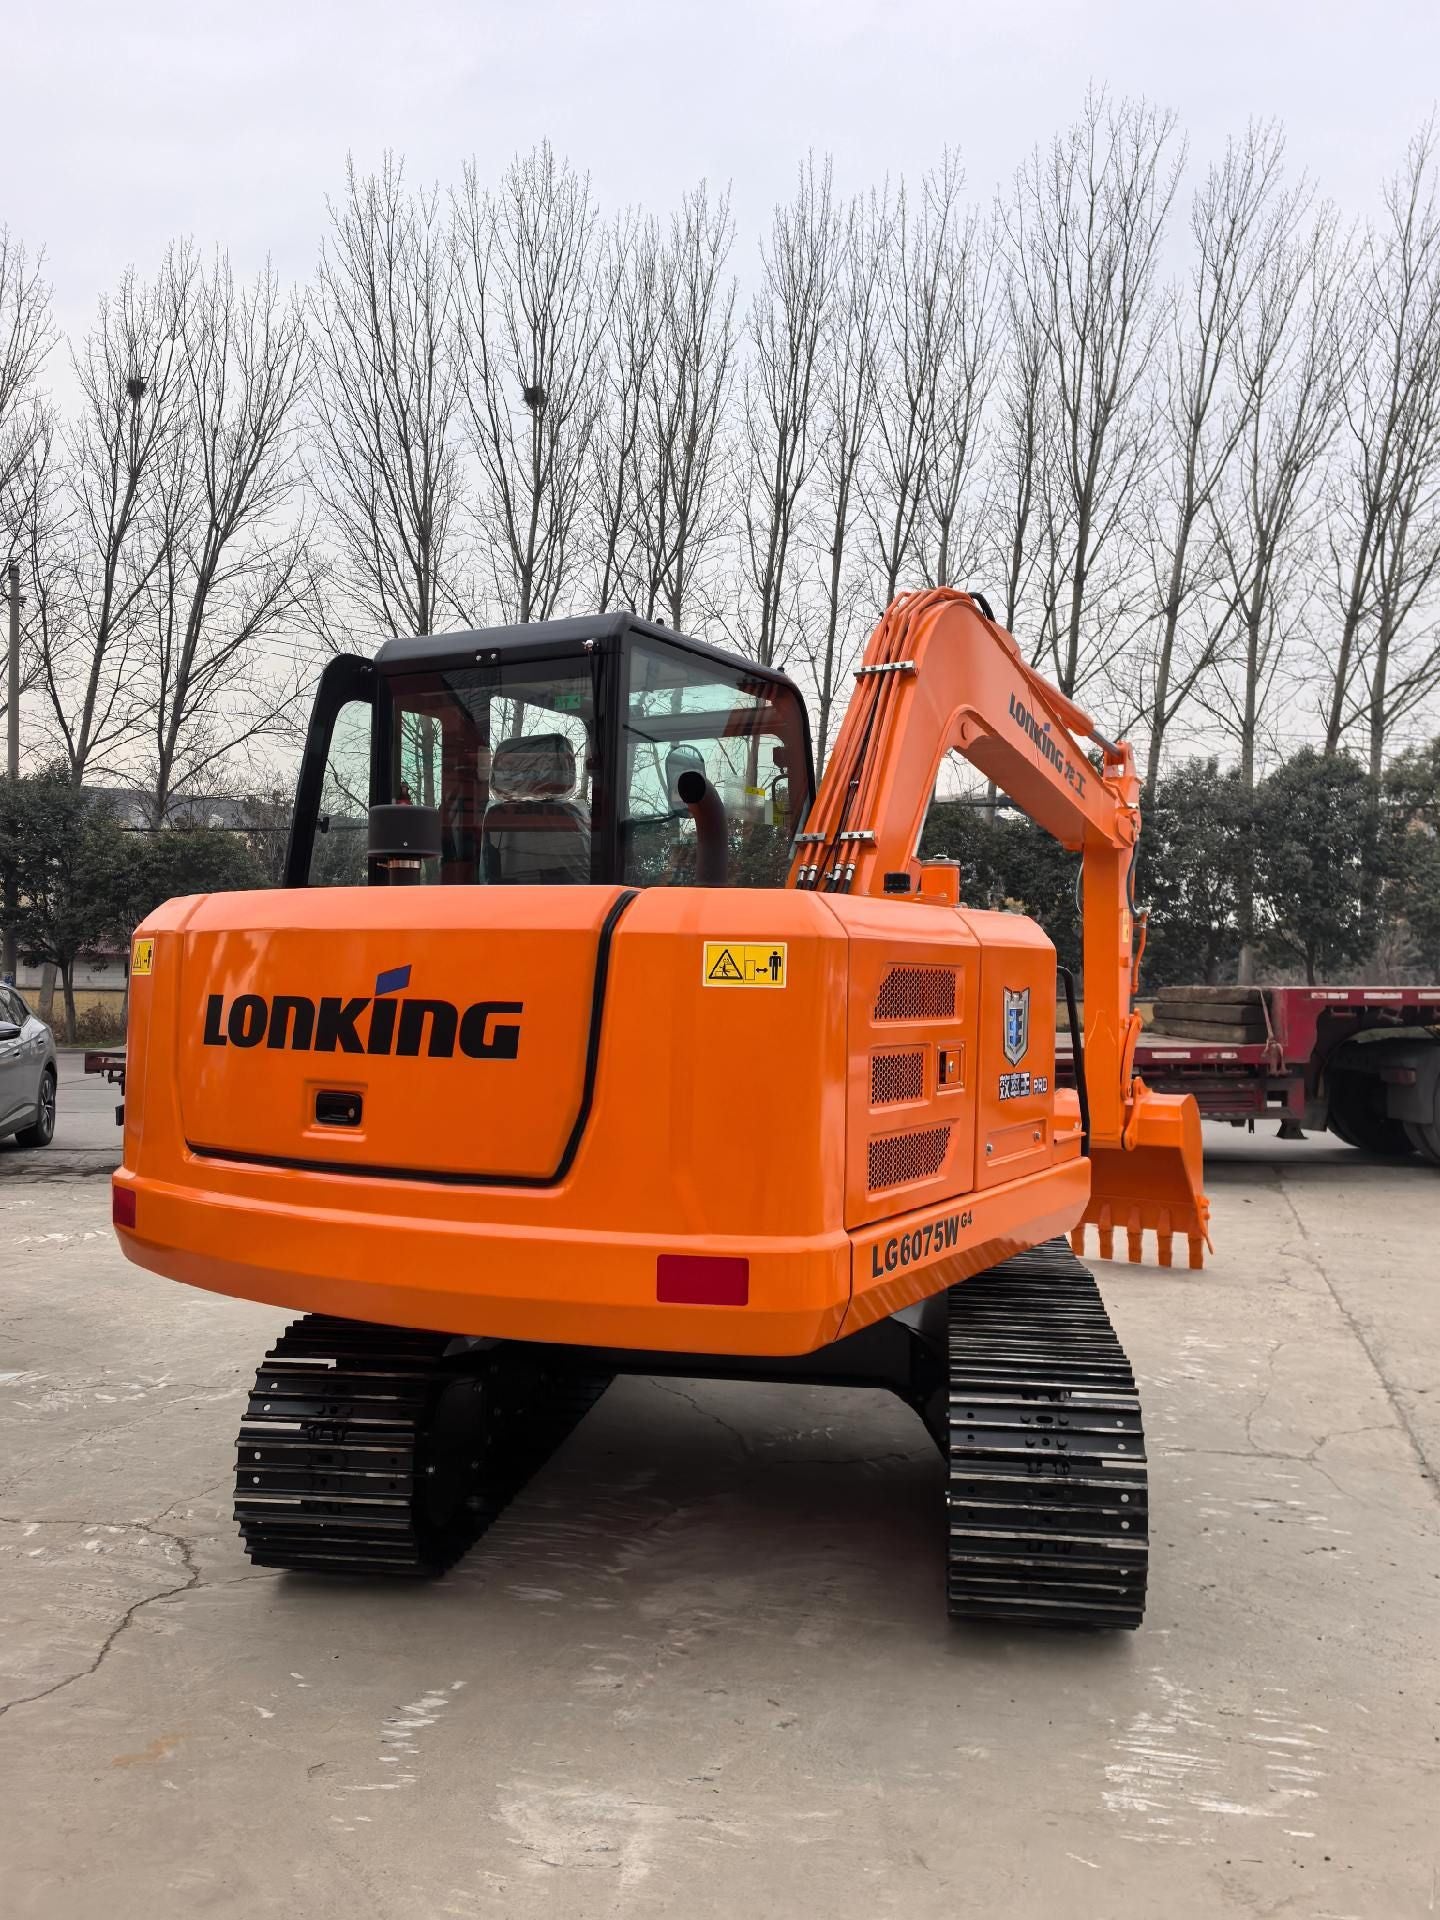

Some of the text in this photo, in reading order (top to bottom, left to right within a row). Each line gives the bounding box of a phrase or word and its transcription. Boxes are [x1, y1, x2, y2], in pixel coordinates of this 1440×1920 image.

[1008, 692, 1064, 775] LONKING
[203, 965, 523, 1059] LONKING
[1033, 1077, 1048, 1094] PRO
[872, 1216, 959, 1278] LG6075W
